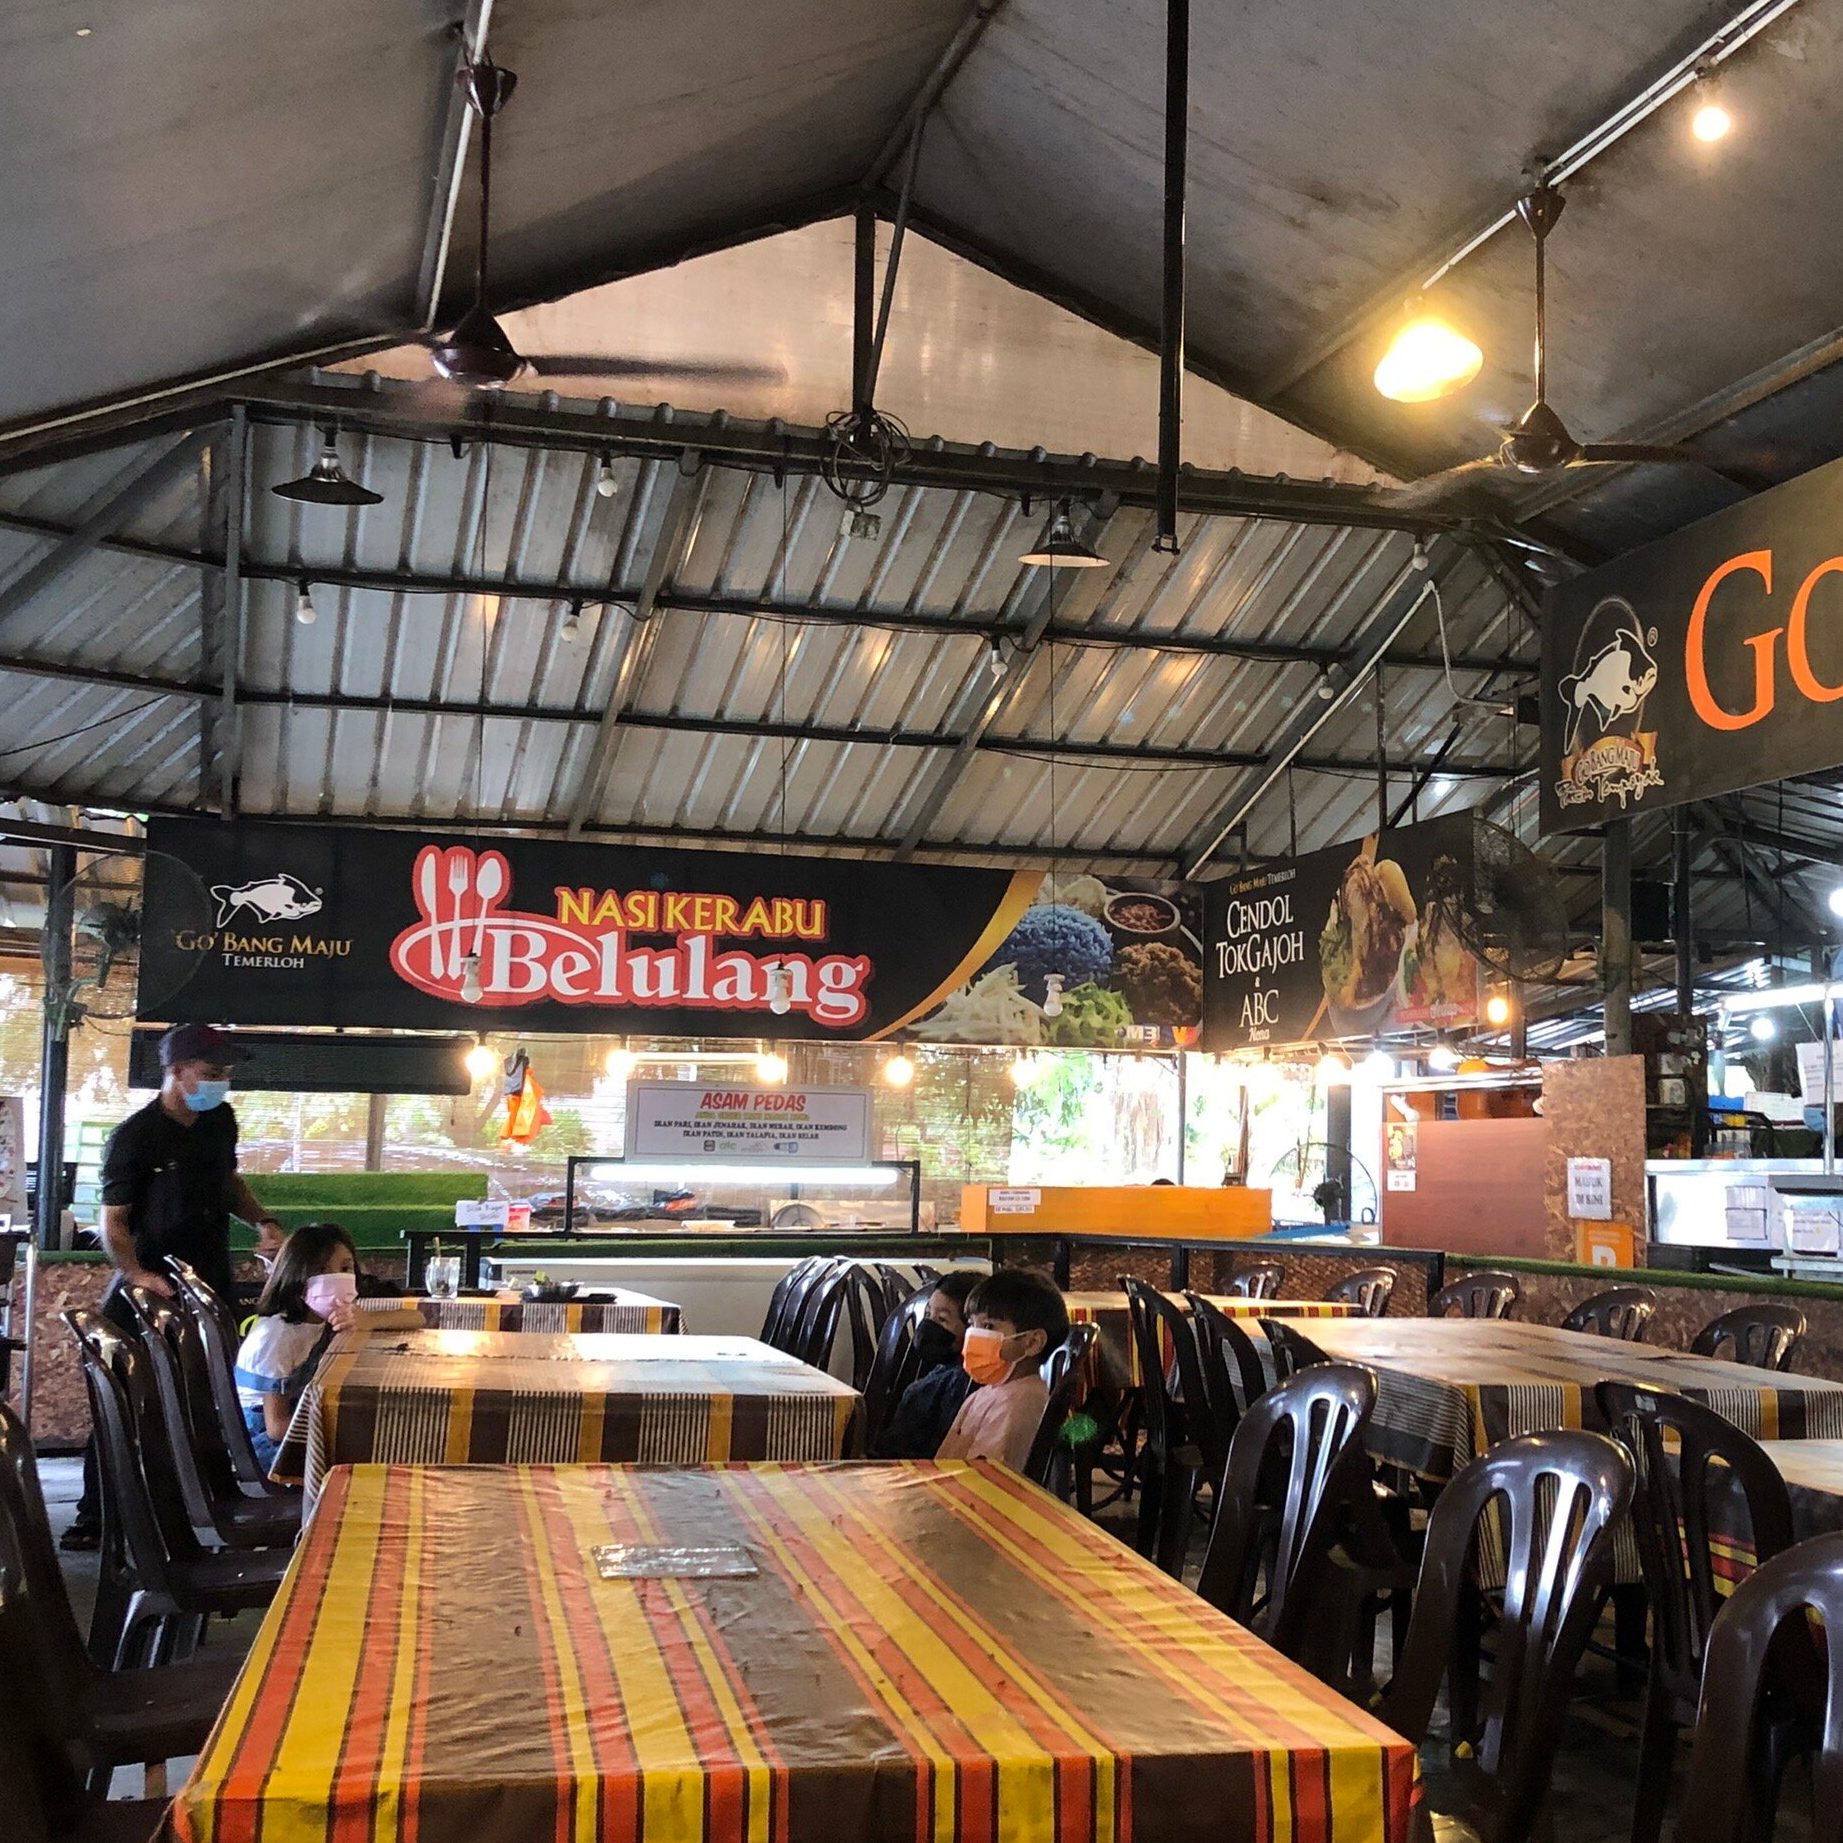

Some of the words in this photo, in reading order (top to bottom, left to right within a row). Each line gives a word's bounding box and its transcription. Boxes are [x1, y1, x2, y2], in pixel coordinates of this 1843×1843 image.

[555, 890, 655, 928] NASI
[665, 896, 823, 936] KERABU
[1227, 894, 1293, 940] CENDOL
[223, 931, 284, 954] BANG
[290, 934, 352, 960] MAJU
[221, 952, 305, 969] TEMERLOH
[485, 929, 864, 1020] Belulang
[1239, 989, 1279, 1028] ABC
[700, 1092, 749, 1110] ASAM
[754, 1094, 807, 1112] PEDAS
[654, 1120, 673, 1128] IKAN
[693, 1121, 712, 1129] IKAN
[750, 1122, 767, 1130] IKAN
[683, 1130, 701, 1138] IKAN
[726, 1131, 745, 1139] IKAN
[779, 1132, 797, 1140] IKAN
